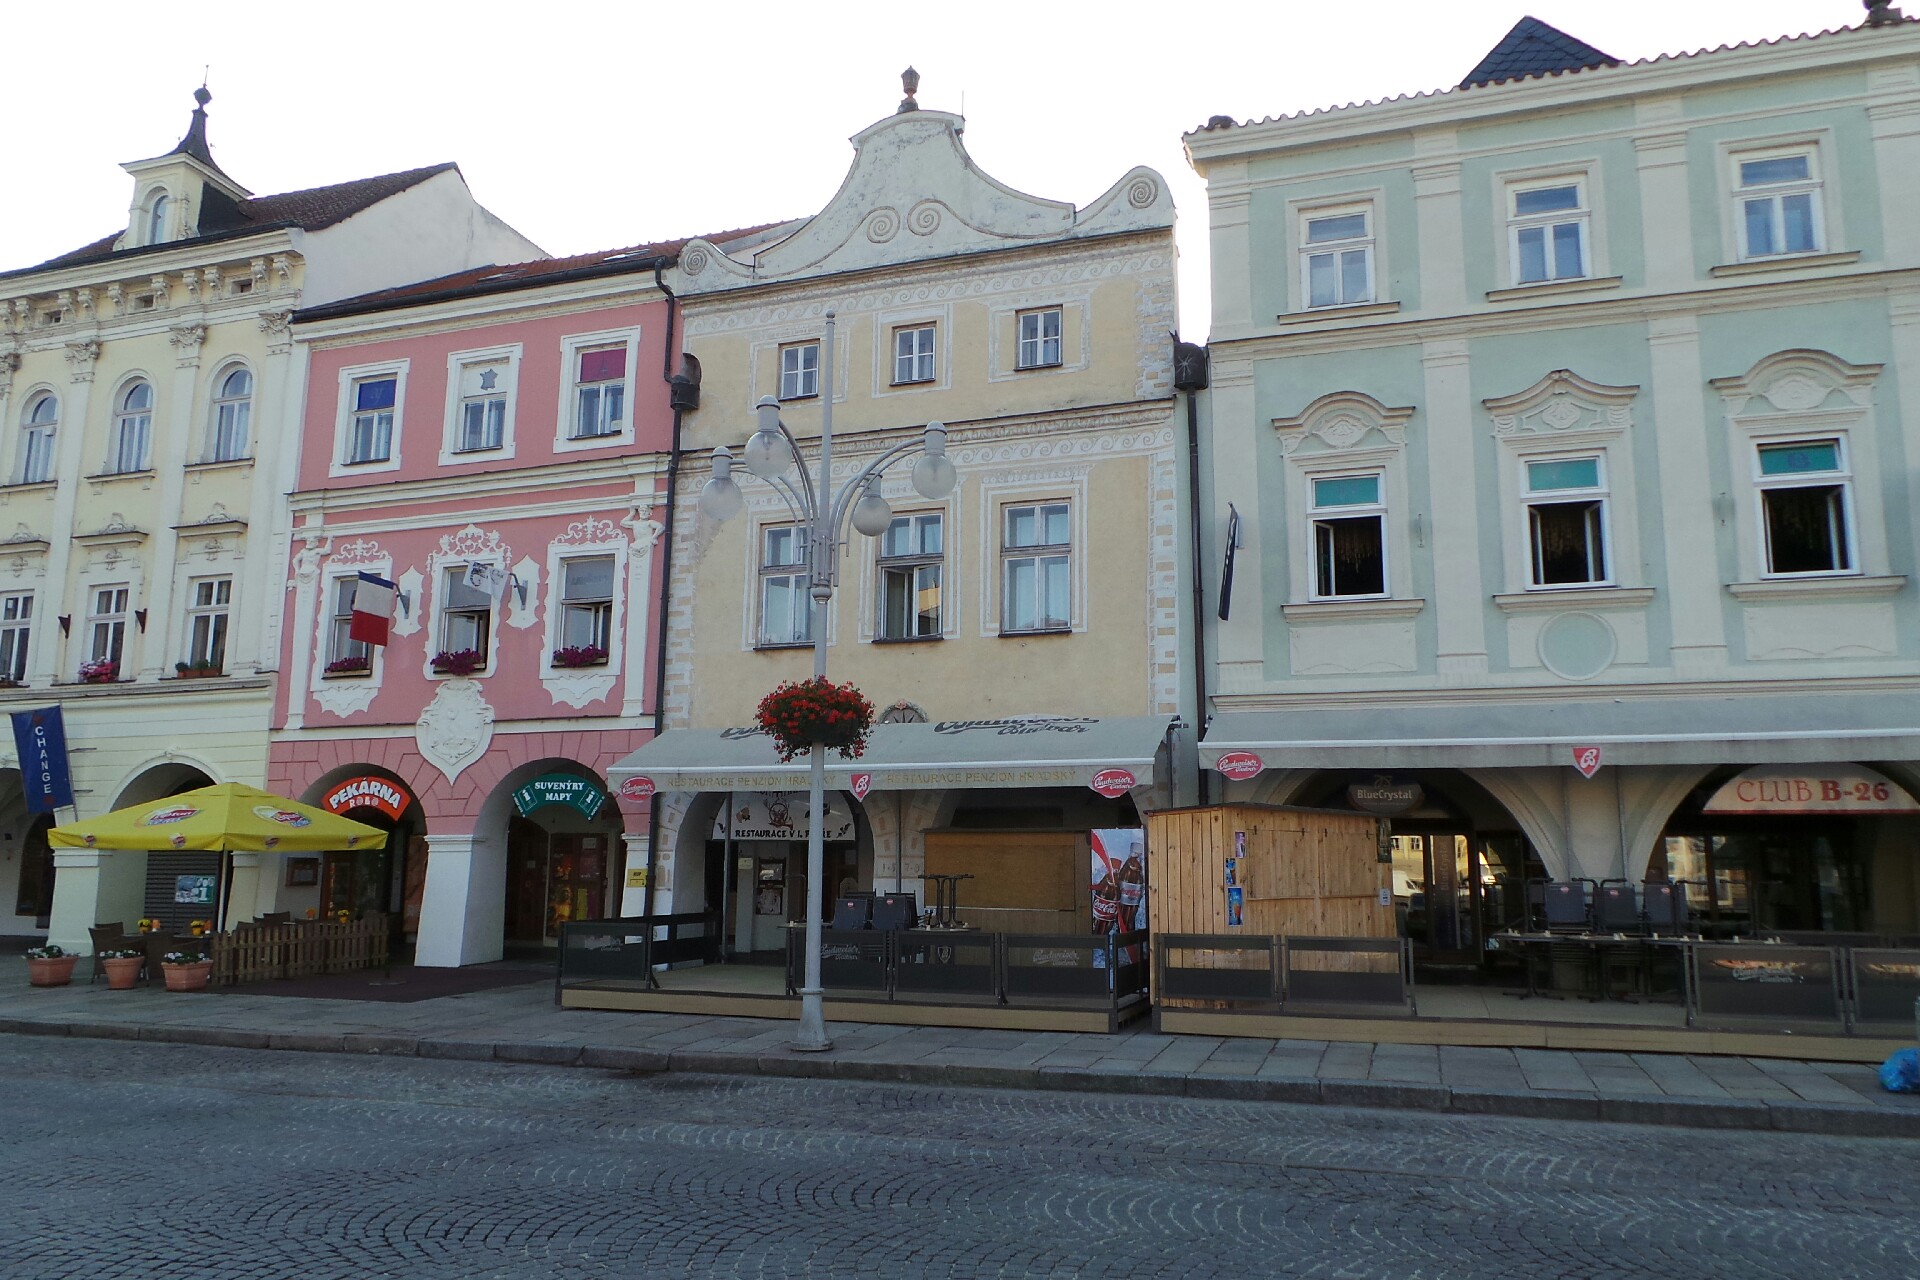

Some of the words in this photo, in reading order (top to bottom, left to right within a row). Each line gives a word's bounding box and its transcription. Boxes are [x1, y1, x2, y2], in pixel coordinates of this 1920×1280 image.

[34, 726, 52, 794] CHANGE
[667, 777, 735, 787] RESTAURACE
[737, 776, 782, 786] PENZION
[887, 772, 962, 784] RESTAURACE
[965, 771, 1015, 783] PENZION
[534, 779, 585, 791] SUVENÝRY
[1736, 779, 1813, 802] CLUB
[1818, 779, 1890, 802] B-26
[329, 777, 401, 809] PEKÁRNA
[545, 792, 573, 801] MAPY
[1357, 789, 1413, 801] BlueCrystal
[735, 829, 787, 838] RESTAURACE
[789, 830, 795, 838] V
